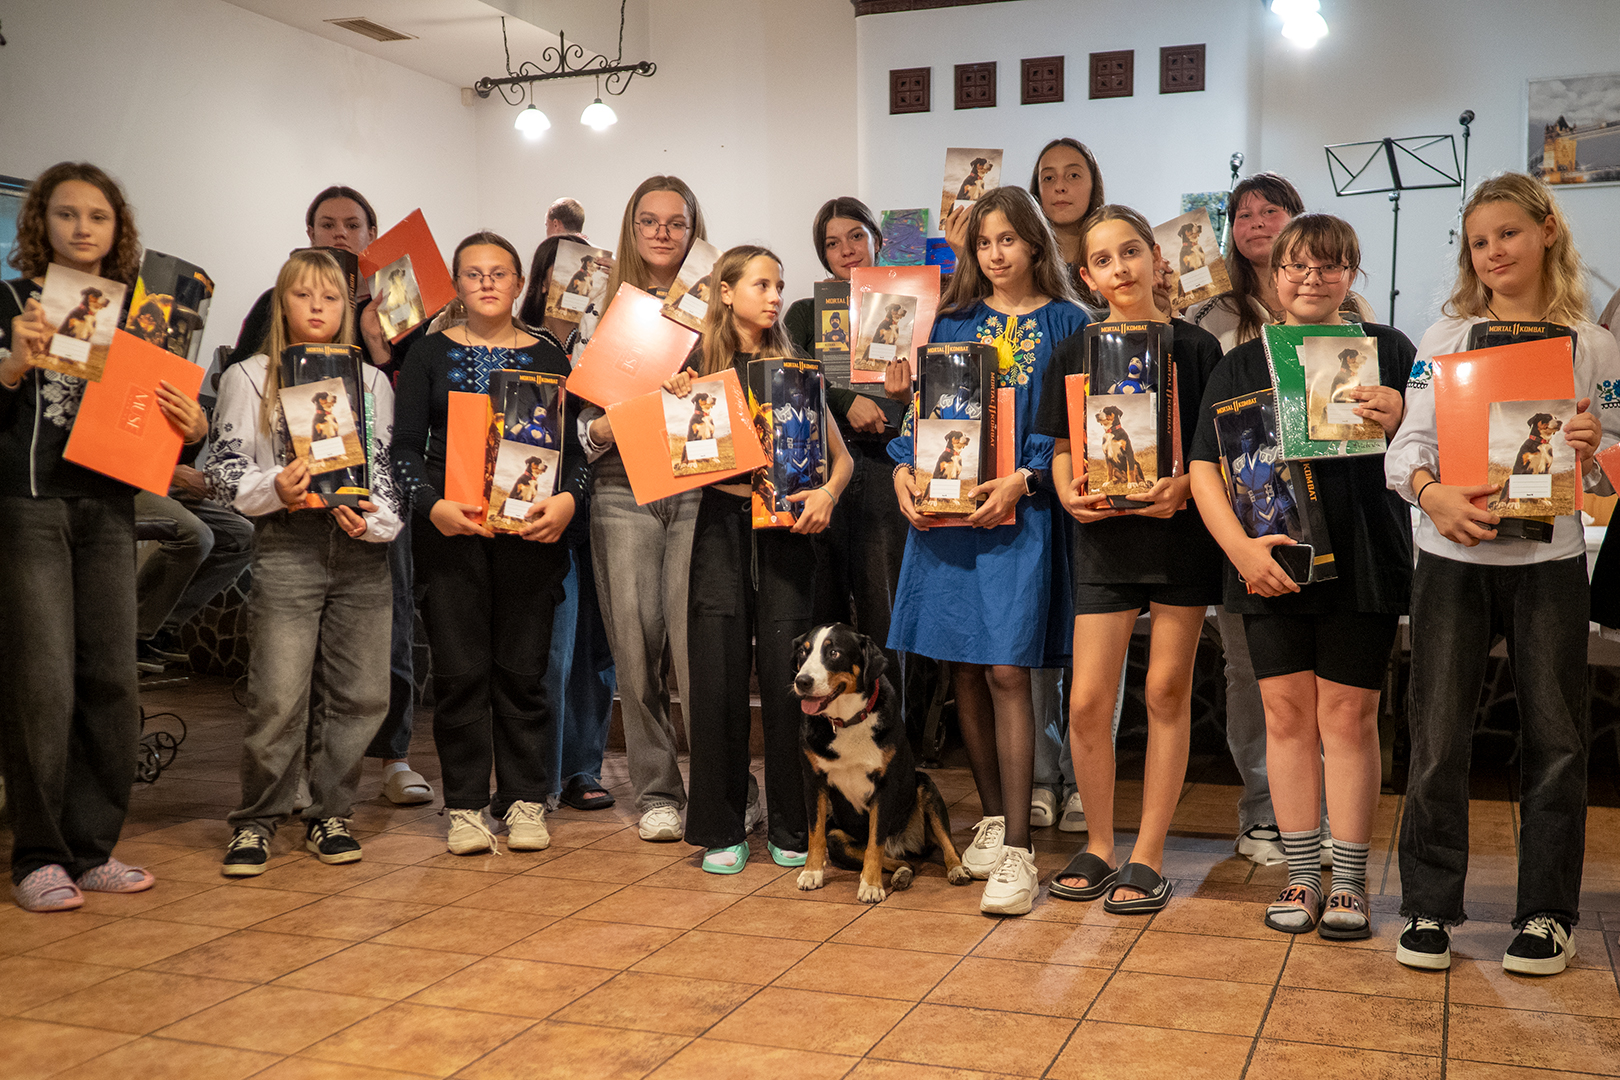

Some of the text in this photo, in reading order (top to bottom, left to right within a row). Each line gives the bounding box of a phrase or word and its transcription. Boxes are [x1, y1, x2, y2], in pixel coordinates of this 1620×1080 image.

[126, 390, 149, 432] MUSE
[1216, 404, 1234, 414] MORTAL
[1238, 397, 1257, 408] KOMBAT
[1302, 462, 1318, 502] KOMBAT
[1275, 888, 1306, 904] SEA
